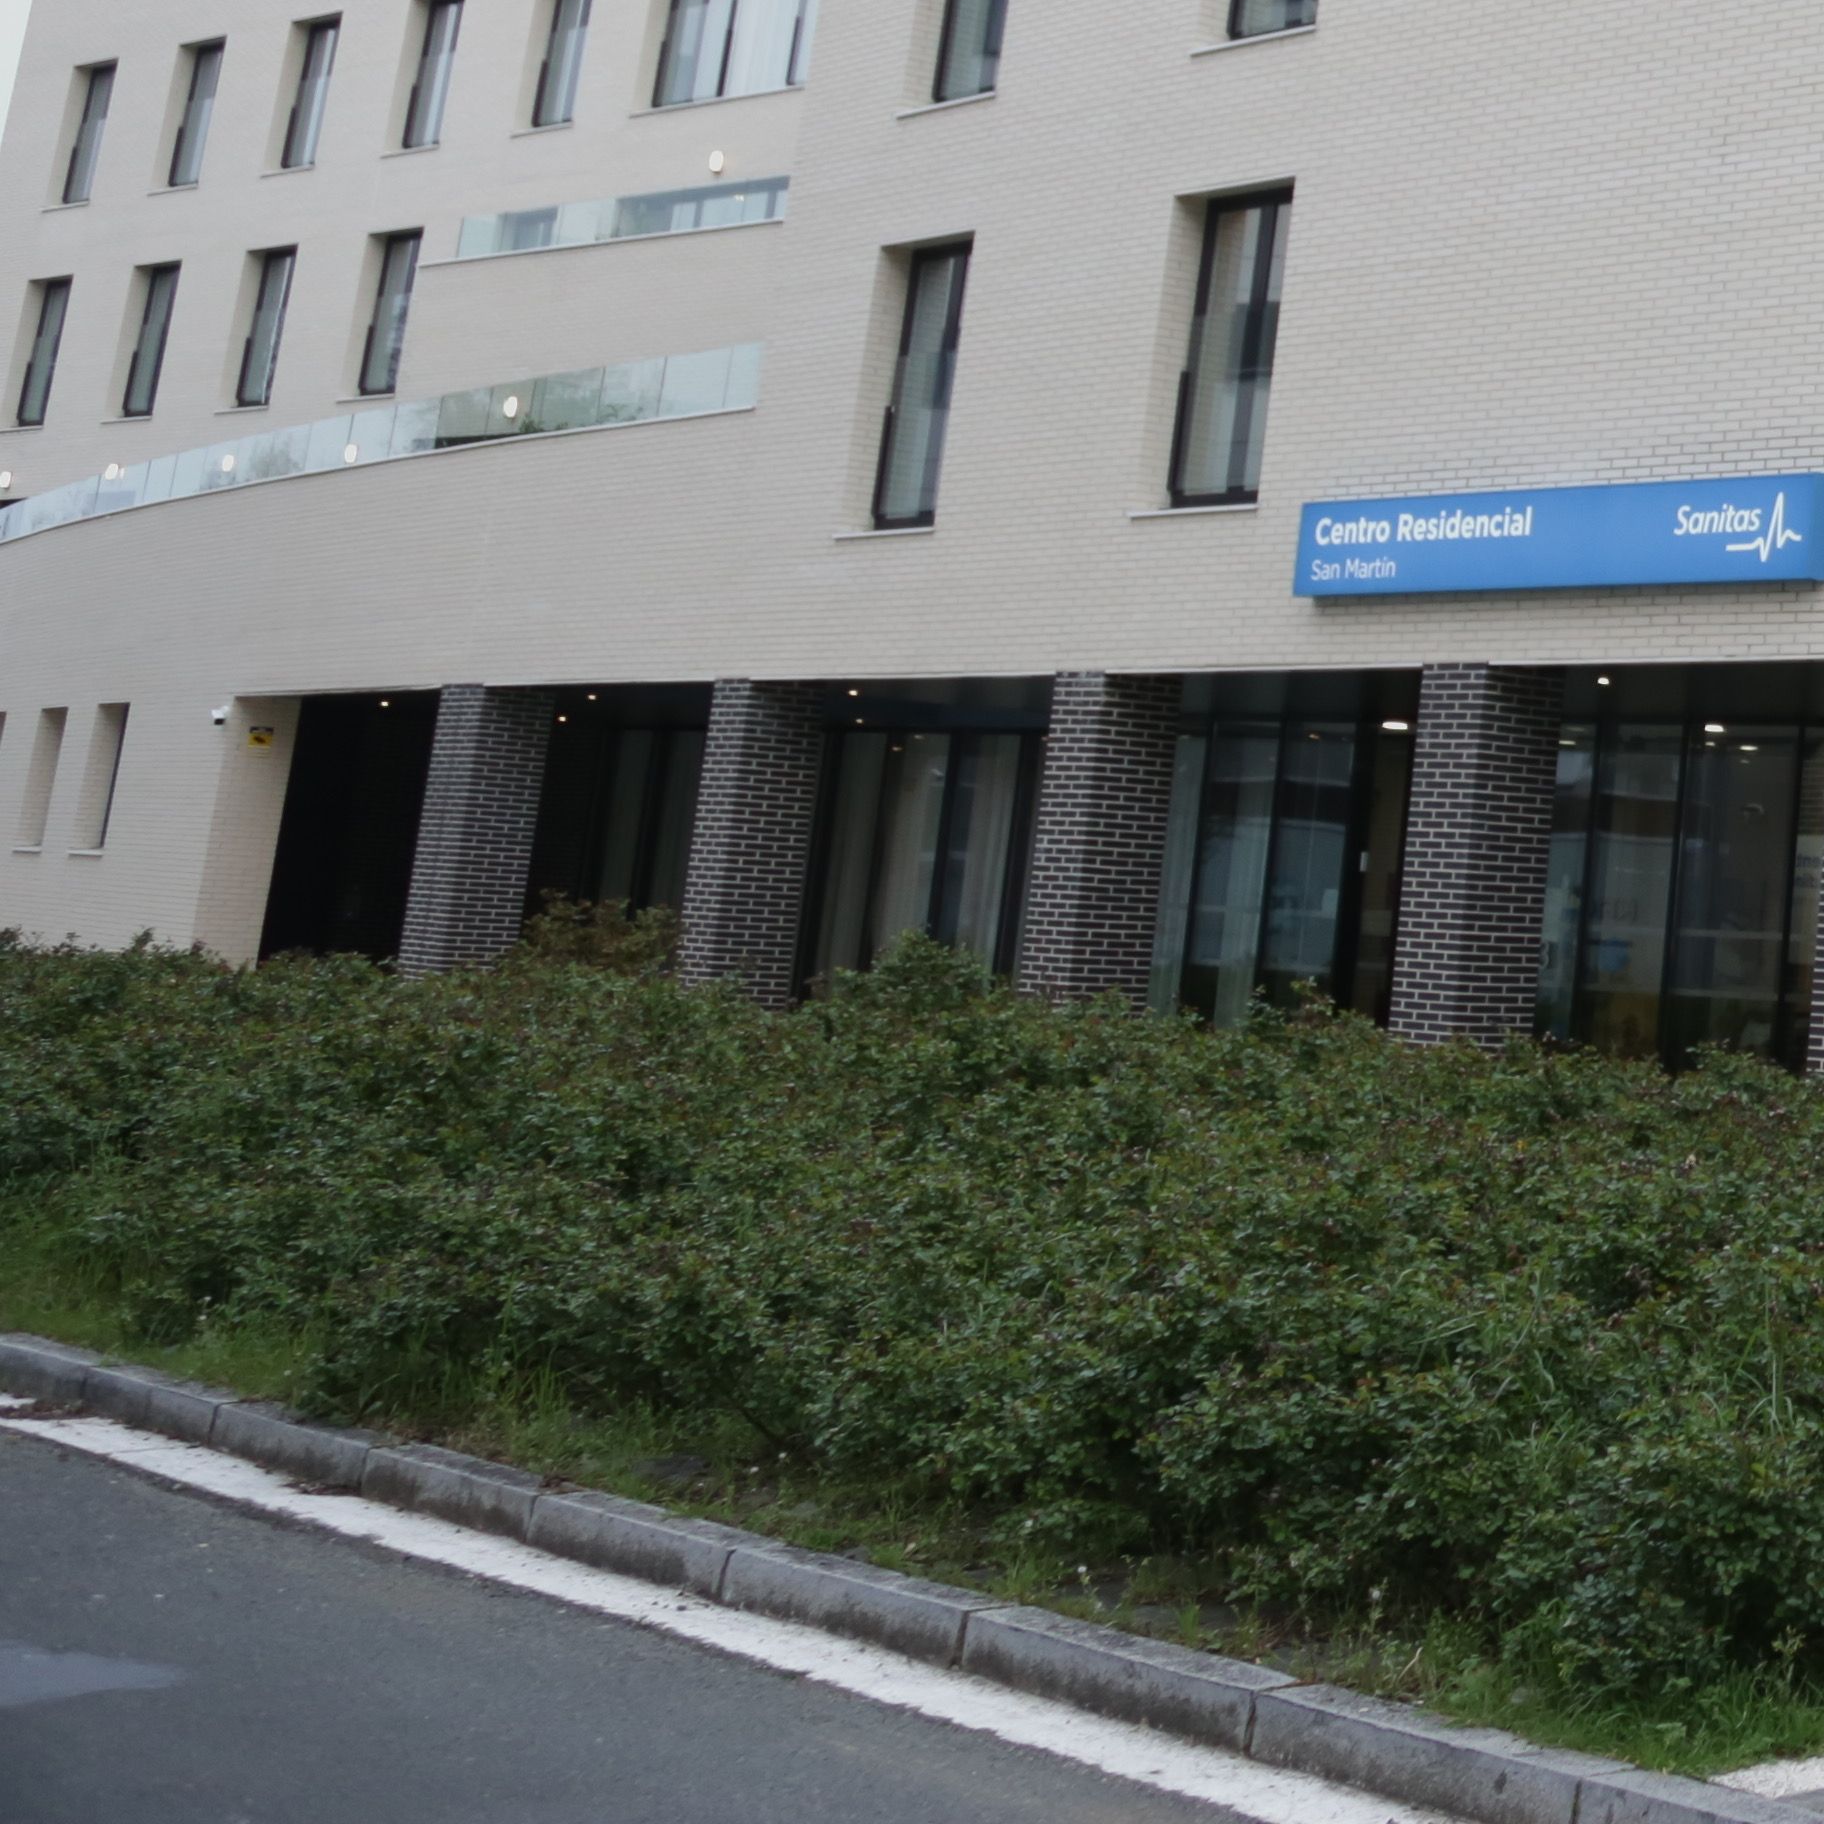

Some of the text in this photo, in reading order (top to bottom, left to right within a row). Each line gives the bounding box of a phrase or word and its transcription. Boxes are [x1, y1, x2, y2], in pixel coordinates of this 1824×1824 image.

[1314, 506, 1533, 546] Centro Residencial
[1672, 504, 1761, 537] Sanitas
[1310, 558, 1340, 581] San
